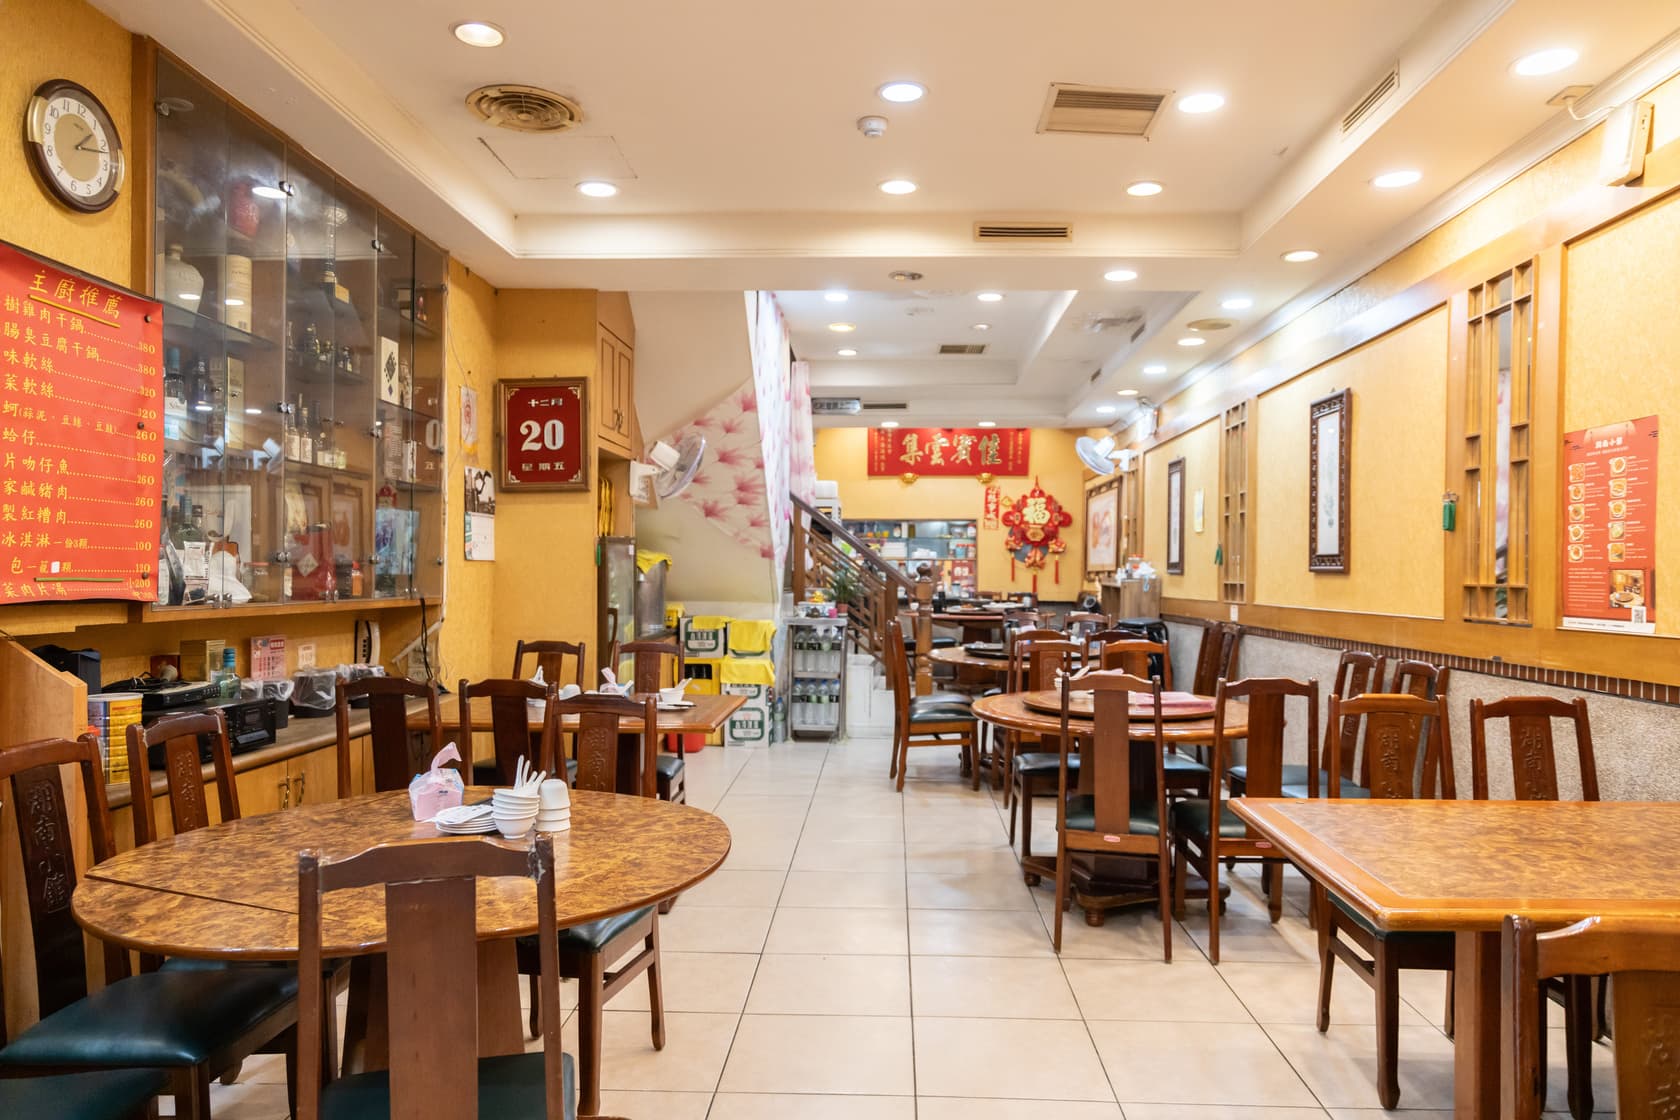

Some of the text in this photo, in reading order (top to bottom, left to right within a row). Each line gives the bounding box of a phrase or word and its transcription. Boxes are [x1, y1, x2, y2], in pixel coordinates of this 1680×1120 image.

[63, 99, 70, 112] 11
[77, 104, 86, 118] 12
[50, 105, 59, 119] 10
[45, 123, 51, 135] 9
[93, 120, 97, 130] 1
[47, 145, 53, 157] 8
[101, 140, 107, 151] 2
[57, 166, 63, 176] 7
[103, 160, 108, 171] 3
[70, 180, 77, 192] 6
[29, 270, 123, 319] 主廚推薦
[3, 348, 54, 373] 味軟絲
[138, 364, 156, 376] 380
[4, 373, 54, 399] 菜軟絲
[527, 398, 563, 408] 十二月
[136, 431, 157, 441] 260
[520, 419, 564, 451] 20
[136, 453, 156, 463] 260
[3, 453, 155, 485] 片吻仔魚 260
[3, 478, 154, 507] 家鹹豬肉 260
[1022, 498, 1050, 524] 福
[134, 519, 153, 529] 260
[135, 541, 152, 551] 100
